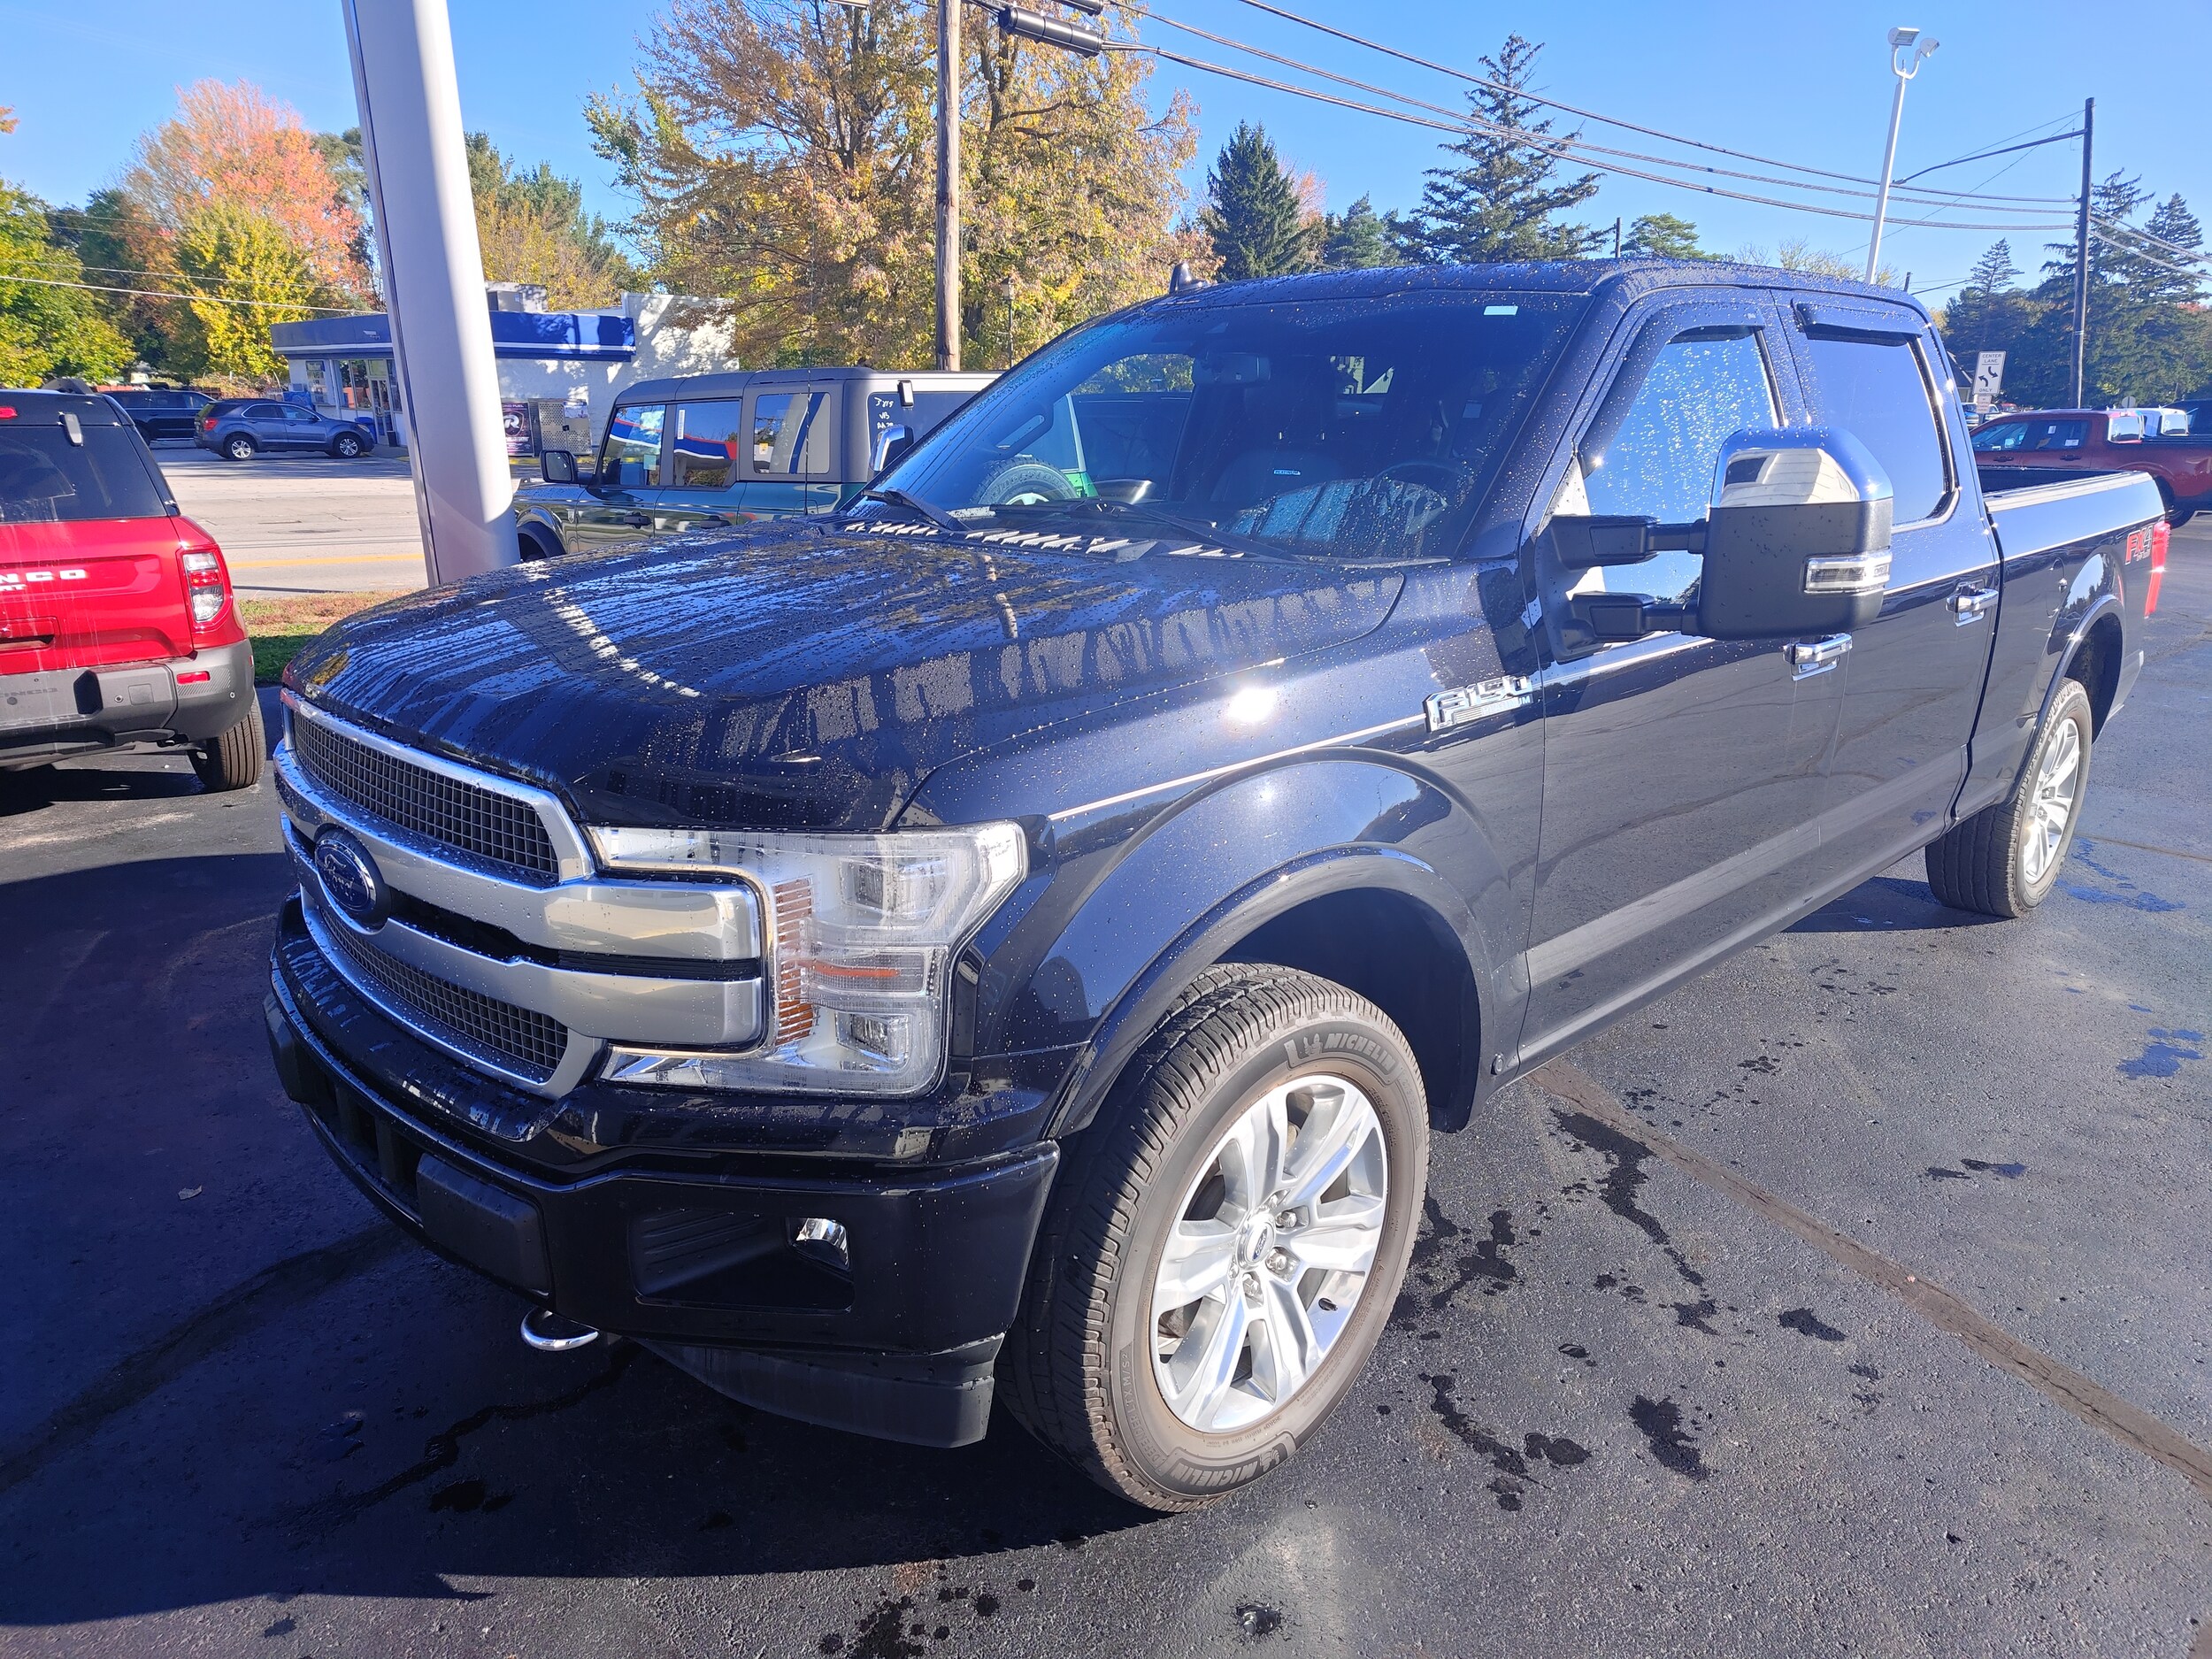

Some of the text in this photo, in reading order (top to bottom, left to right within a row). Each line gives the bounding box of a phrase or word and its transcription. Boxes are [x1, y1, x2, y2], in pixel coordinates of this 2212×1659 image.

[2125, 524, 2154, 565] FX4
[322, 853, 356, 902] Ford
[1324, 1033, 1396, 1072] MICHELIN
[1129, 1415, 1161, 1463] DEFENDER
[1170, 1460, 1259, 1487] MICHELIN
